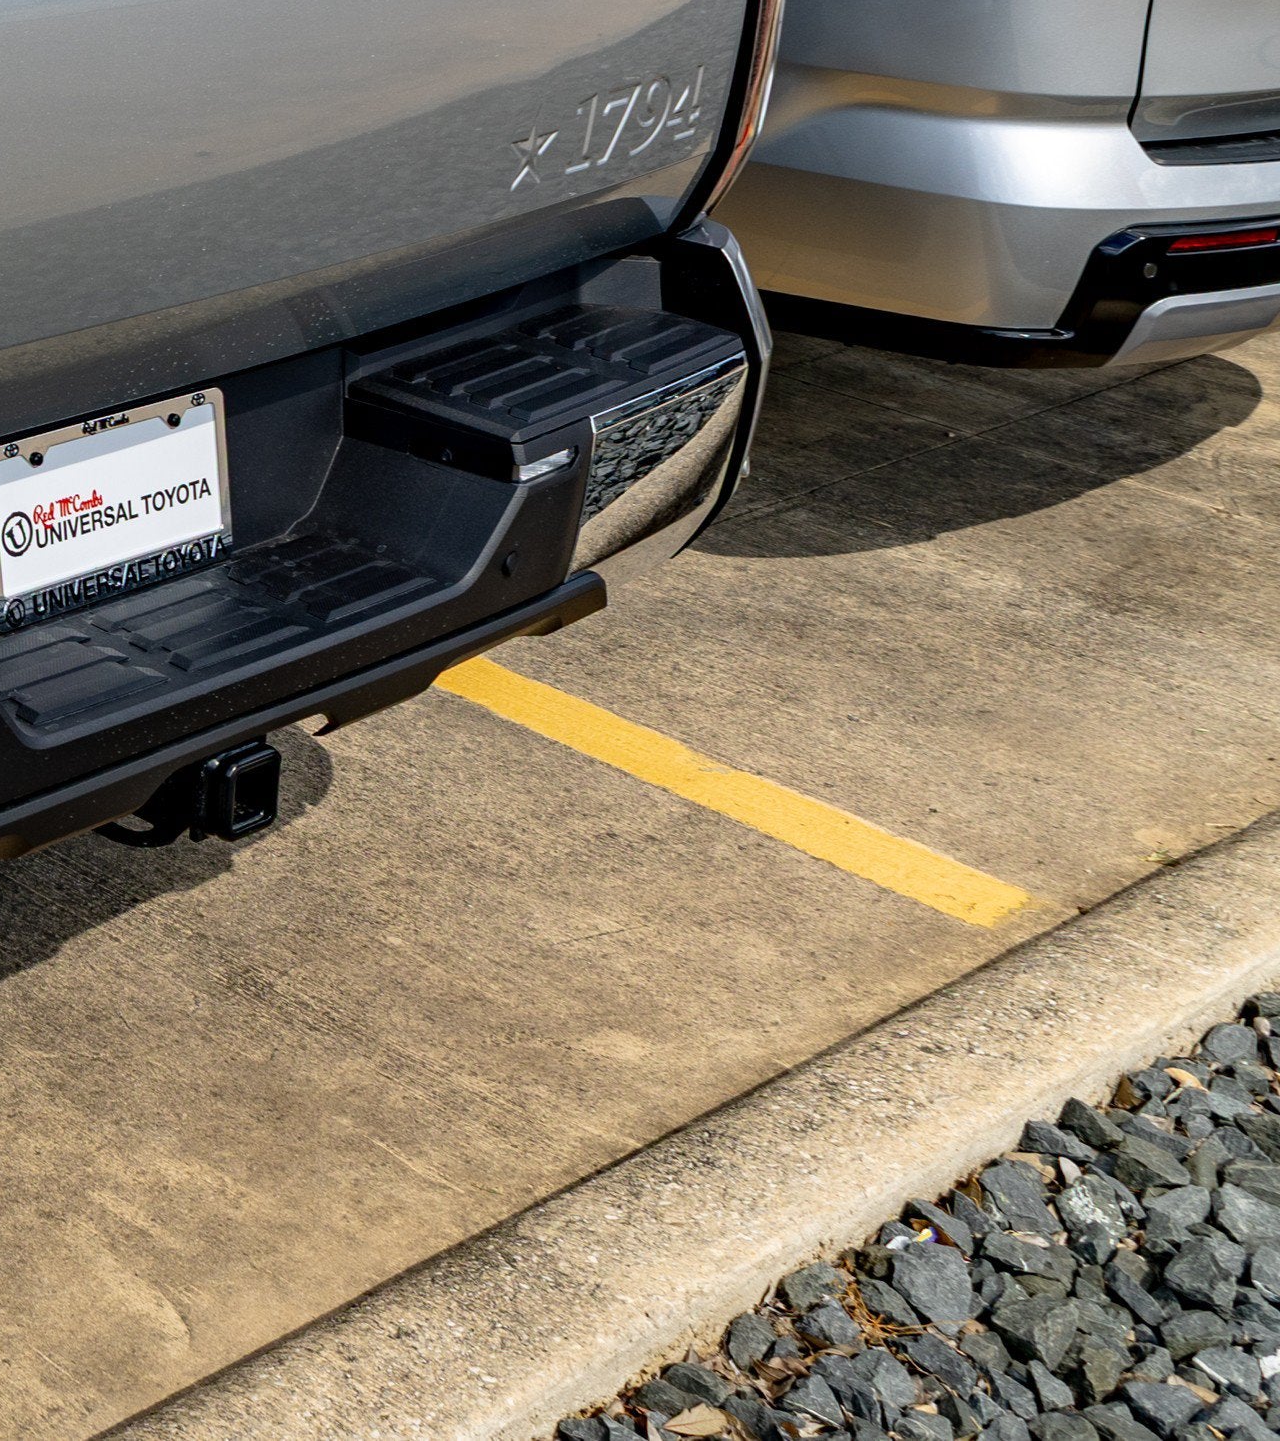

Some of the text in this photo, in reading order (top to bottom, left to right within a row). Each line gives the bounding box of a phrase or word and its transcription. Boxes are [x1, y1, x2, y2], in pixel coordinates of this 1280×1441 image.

[565, 64, 705, 175] 1794
[33, 489, 103, 529] Red McCombs
[35, 500, 139, 549] UNIVERSAL
[141, 478, 211, 514] TOYOTA
[31, 560, 149, 615] UNIVERSAL
[149, 534, 227, 576] TOYOTA
